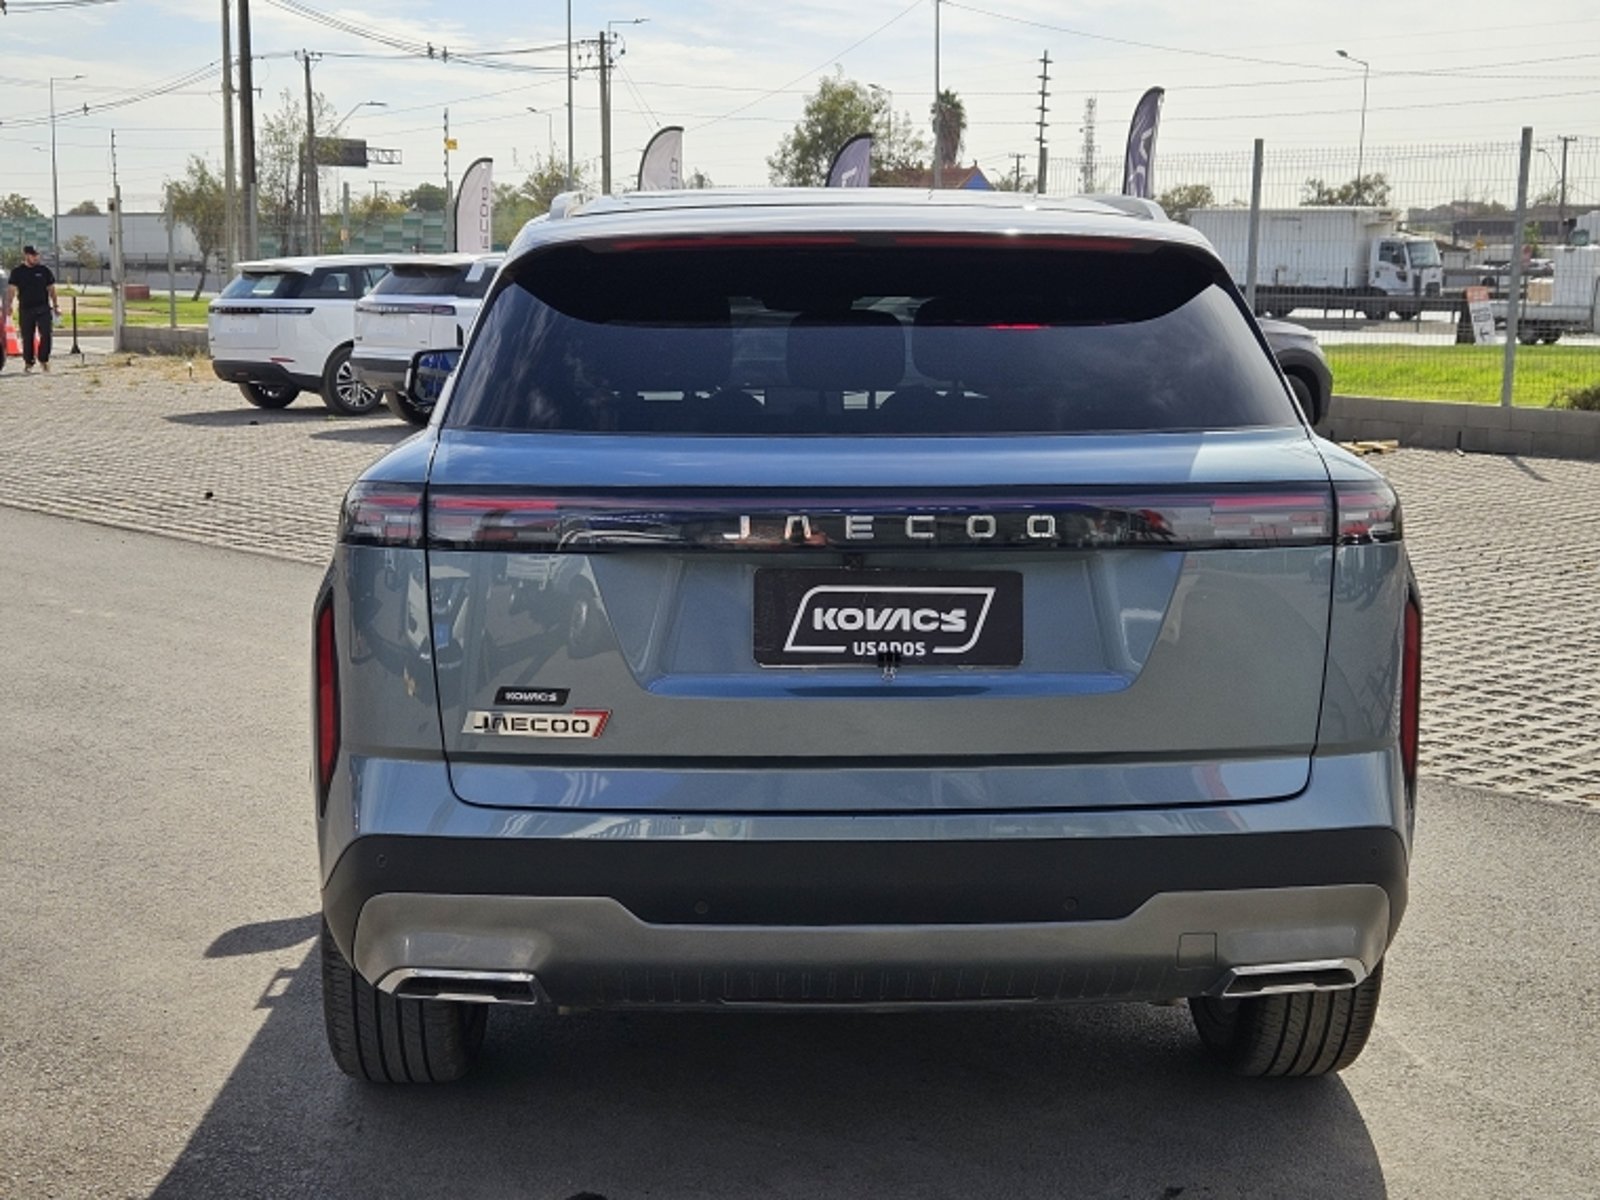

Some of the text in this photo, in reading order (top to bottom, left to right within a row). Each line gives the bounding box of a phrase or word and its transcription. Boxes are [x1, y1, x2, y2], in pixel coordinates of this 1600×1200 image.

[723, 515, 1056, 538] JAECOO
[812, 607, 967, 632] KOVACS
[853, 641, 926, 656] USADOS
[505, 691, 557, 702] KOVACS
[473, 716, 590, 733] JAECOO
